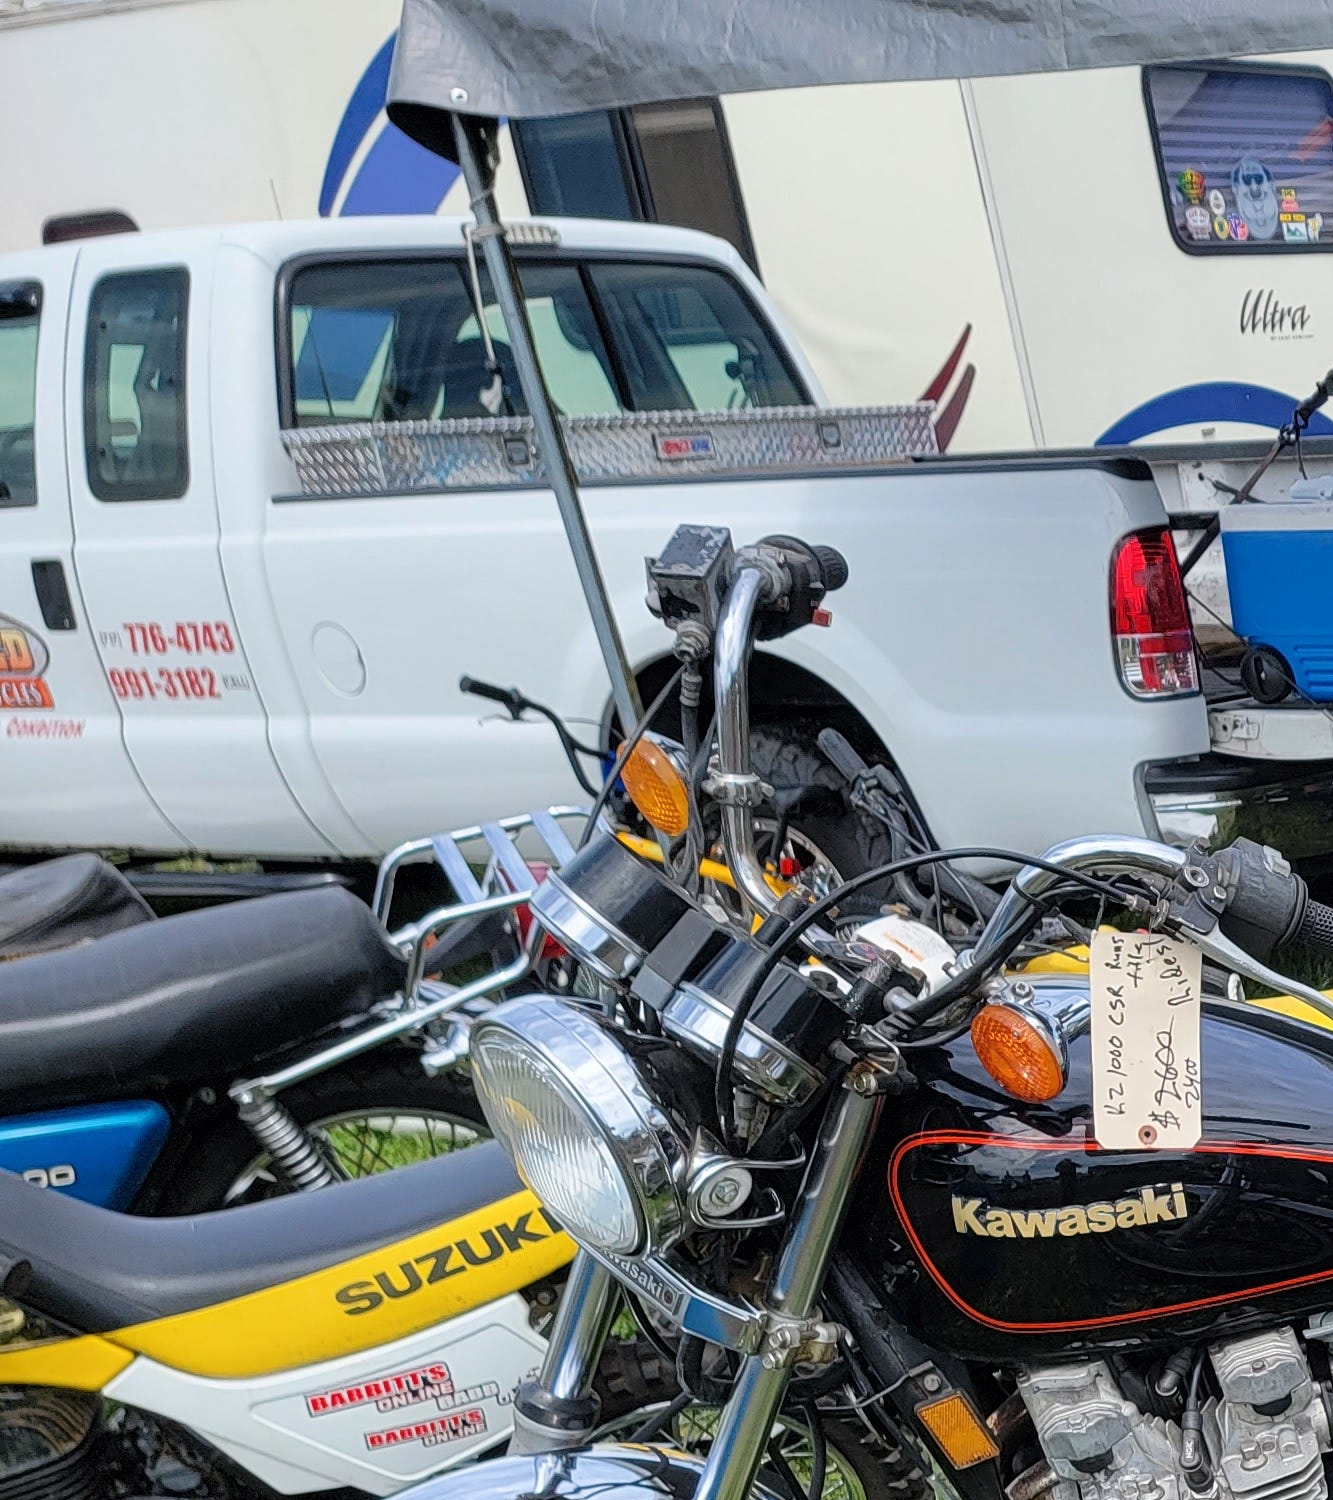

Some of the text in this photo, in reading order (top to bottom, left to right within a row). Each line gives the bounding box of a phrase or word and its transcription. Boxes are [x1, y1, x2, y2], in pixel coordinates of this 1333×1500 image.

[1240, 289, 1311, 335] Ultra
[123, 622, 236, 655] 776-4743
[109, 667, 220, 701] 991-3182
[1106, 985, 1125, 1026] CSR
[953, 1183, 1188, 1239] Kawasaki
[309, 1364, 448, 1412] BABBITT'S
[376, 1381, 455, 1413] ONLINE
[369, 1408, 482, 1447] BABBITT'S
[424, 1423, 487, 1446] ONLINE
